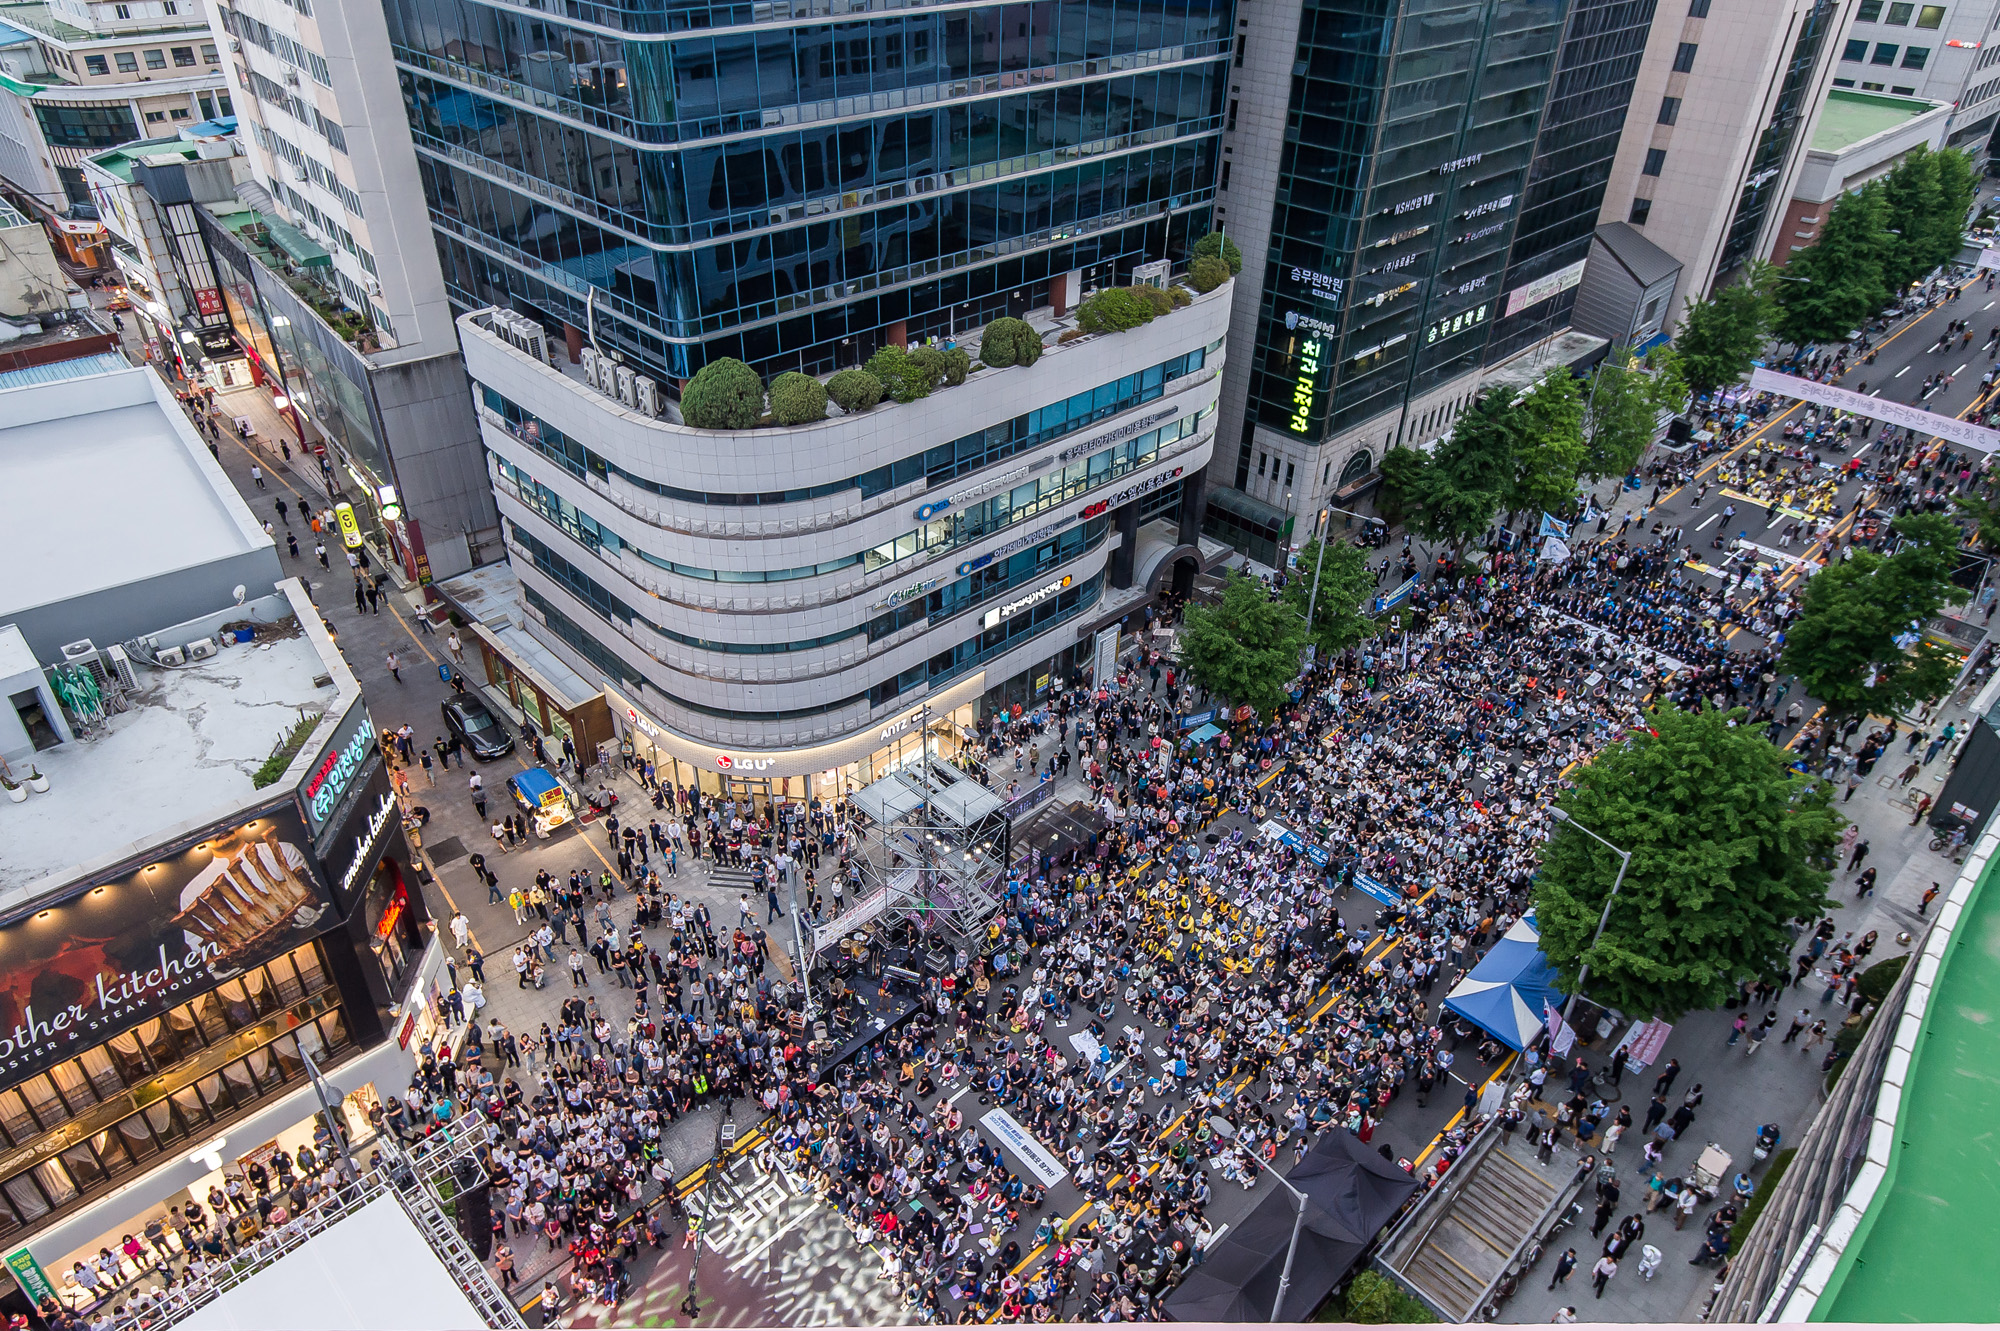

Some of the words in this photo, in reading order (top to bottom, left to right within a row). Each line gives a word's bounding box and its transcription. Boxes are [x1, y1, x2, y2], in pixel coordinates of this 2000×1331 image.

[1290, 267, 1344, 293] 승무원학원
[1458, 275, 1487, 295] 에듀플라잇
[1427, 304, 1487, 343] 승무원학원
[1302, 340, 1321, 375] 치과
[1290, 376, 1314, 433] 교정과
[1109, 469, 1173, 507] 에스엠신용정보
[342, 514, 353, 528] CU
[311, 719, 372, 822] (주)인천상사
[344, 834, 373, 891] another
[367, 790, 397, 840] kitchen
[1285, 831, 1299, 843] The
[95, 941, 223, 1011] kitchen
[68, 1031, 79, 1040] &
[89, 996, 148, 1031] STEAK
[156, 961, 217, 998] HOUSE
[988, 1115, 1001, 1128] 2023
